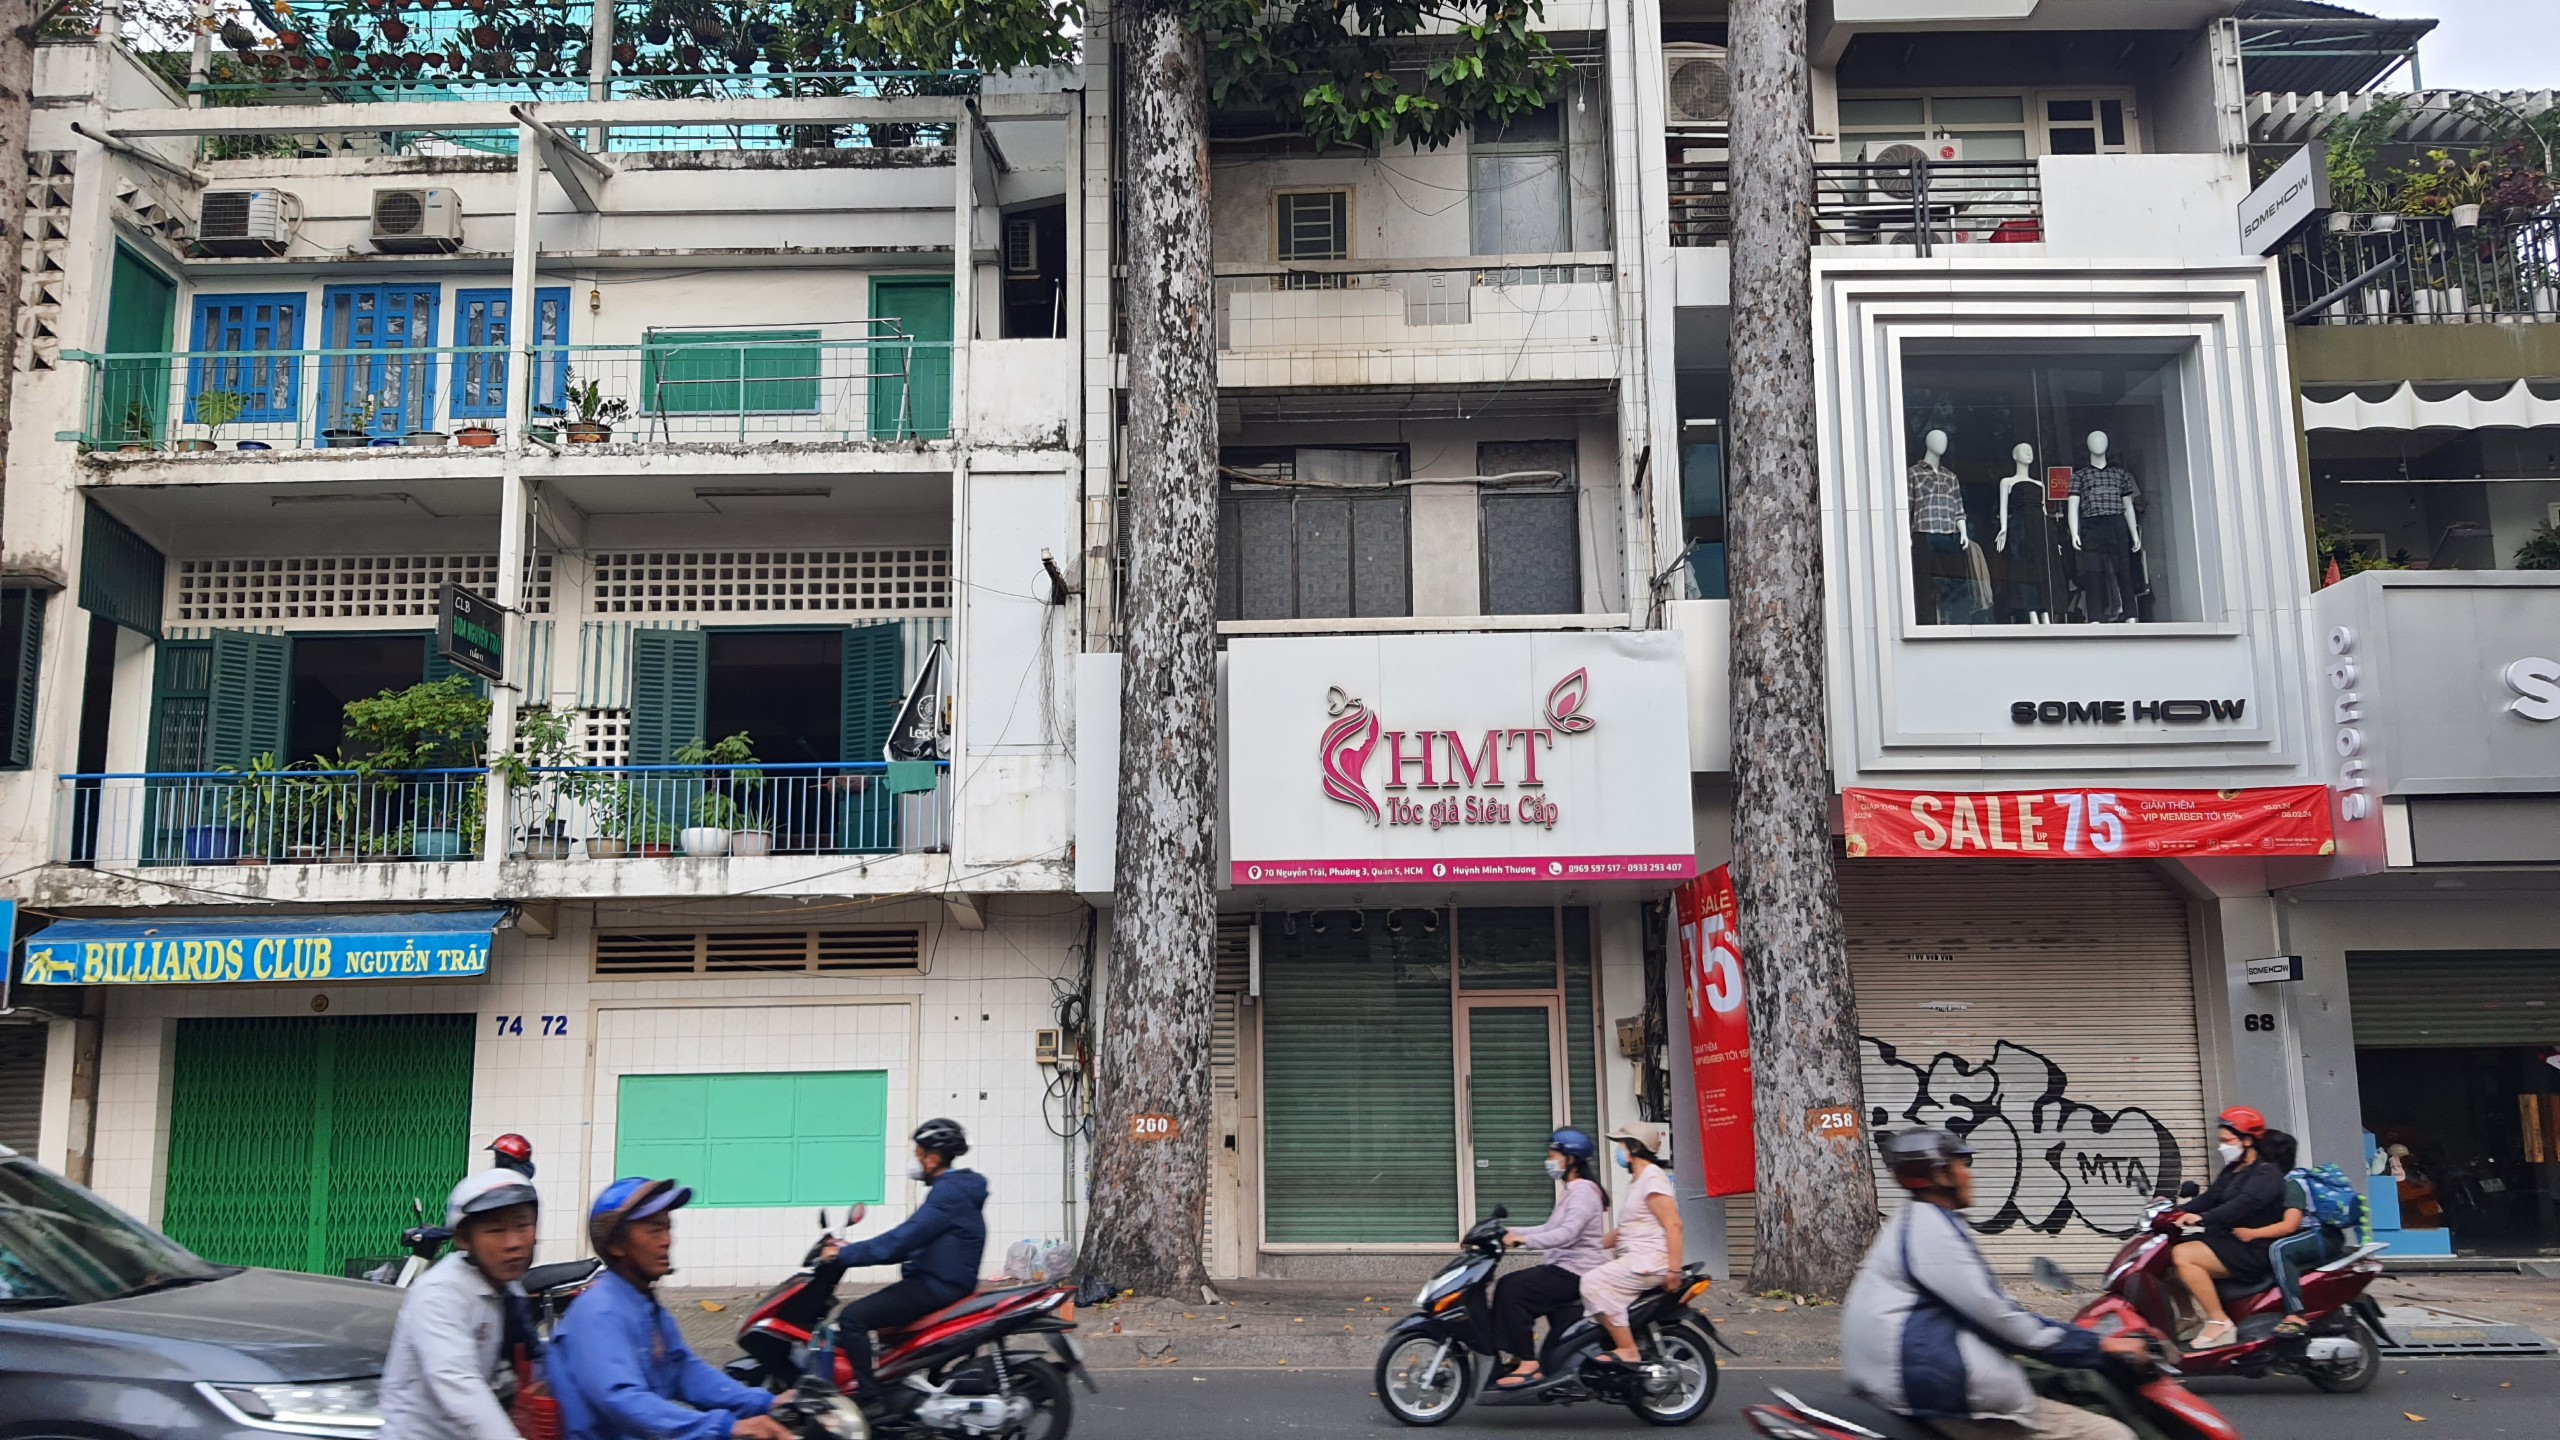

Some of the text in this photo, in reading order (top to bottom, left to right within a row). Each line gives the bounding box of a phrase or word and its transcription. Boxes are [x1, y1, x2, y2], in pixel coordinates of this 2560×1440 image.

[2244, 174, 2308, 238] SOMEHOW
[455, 597, 471, 613] CLB
[2011, 699, 2246, 722] SOME HOW
[2327, 626, 2366, 821] shondo
[1384, 729, 1553, 788] HMT
[1387, 794, 1559, 830] Tóc giả Siêu Cấp
[2140, 801, 2195, 810] GIẢM THÊM
[1911, 794, 2049, 851] SALE
[2037, 832, 2048, 841] UP
[2142, 812, 2242, 821] VIP MEMBER TỚI 15%
[1264, 868, 1274, 877] 70
[1329, 867, 1361, 877] Phường
[1362, 868, 1370, 876] 3,
[1395, 867, 1403, 875] 5,
[1404, 866, 1423, 875] HCM
[1453, 864, 1536, 876] Huỳnh Minh Thương
[1568, 864, 1589, 873] 0969
[1591, 864, 1605, 873] 597
[1607, 864, 1620, 872] 517
[1627, 863, 1648, 872] 0933
[1649, 863, 1665, 872] 293
[1666, 863, 1682, 871] 407
[1700, 889, 1732, 915] SALE
[84, 938, 488, 983] BILLIARDS CLUB NGUYỄN TRÃI
[2249, 964, 2289, 975] SOMEHOW
[496, 1016, 568, 1036] 74 72
[2244, 1014, 2275, 1031] 68
[1136, 1118, 1168, 1133] 260
[1820, 1113, 1853, 1129] 258
[2077, 1152, 2152, 1191] MTA
